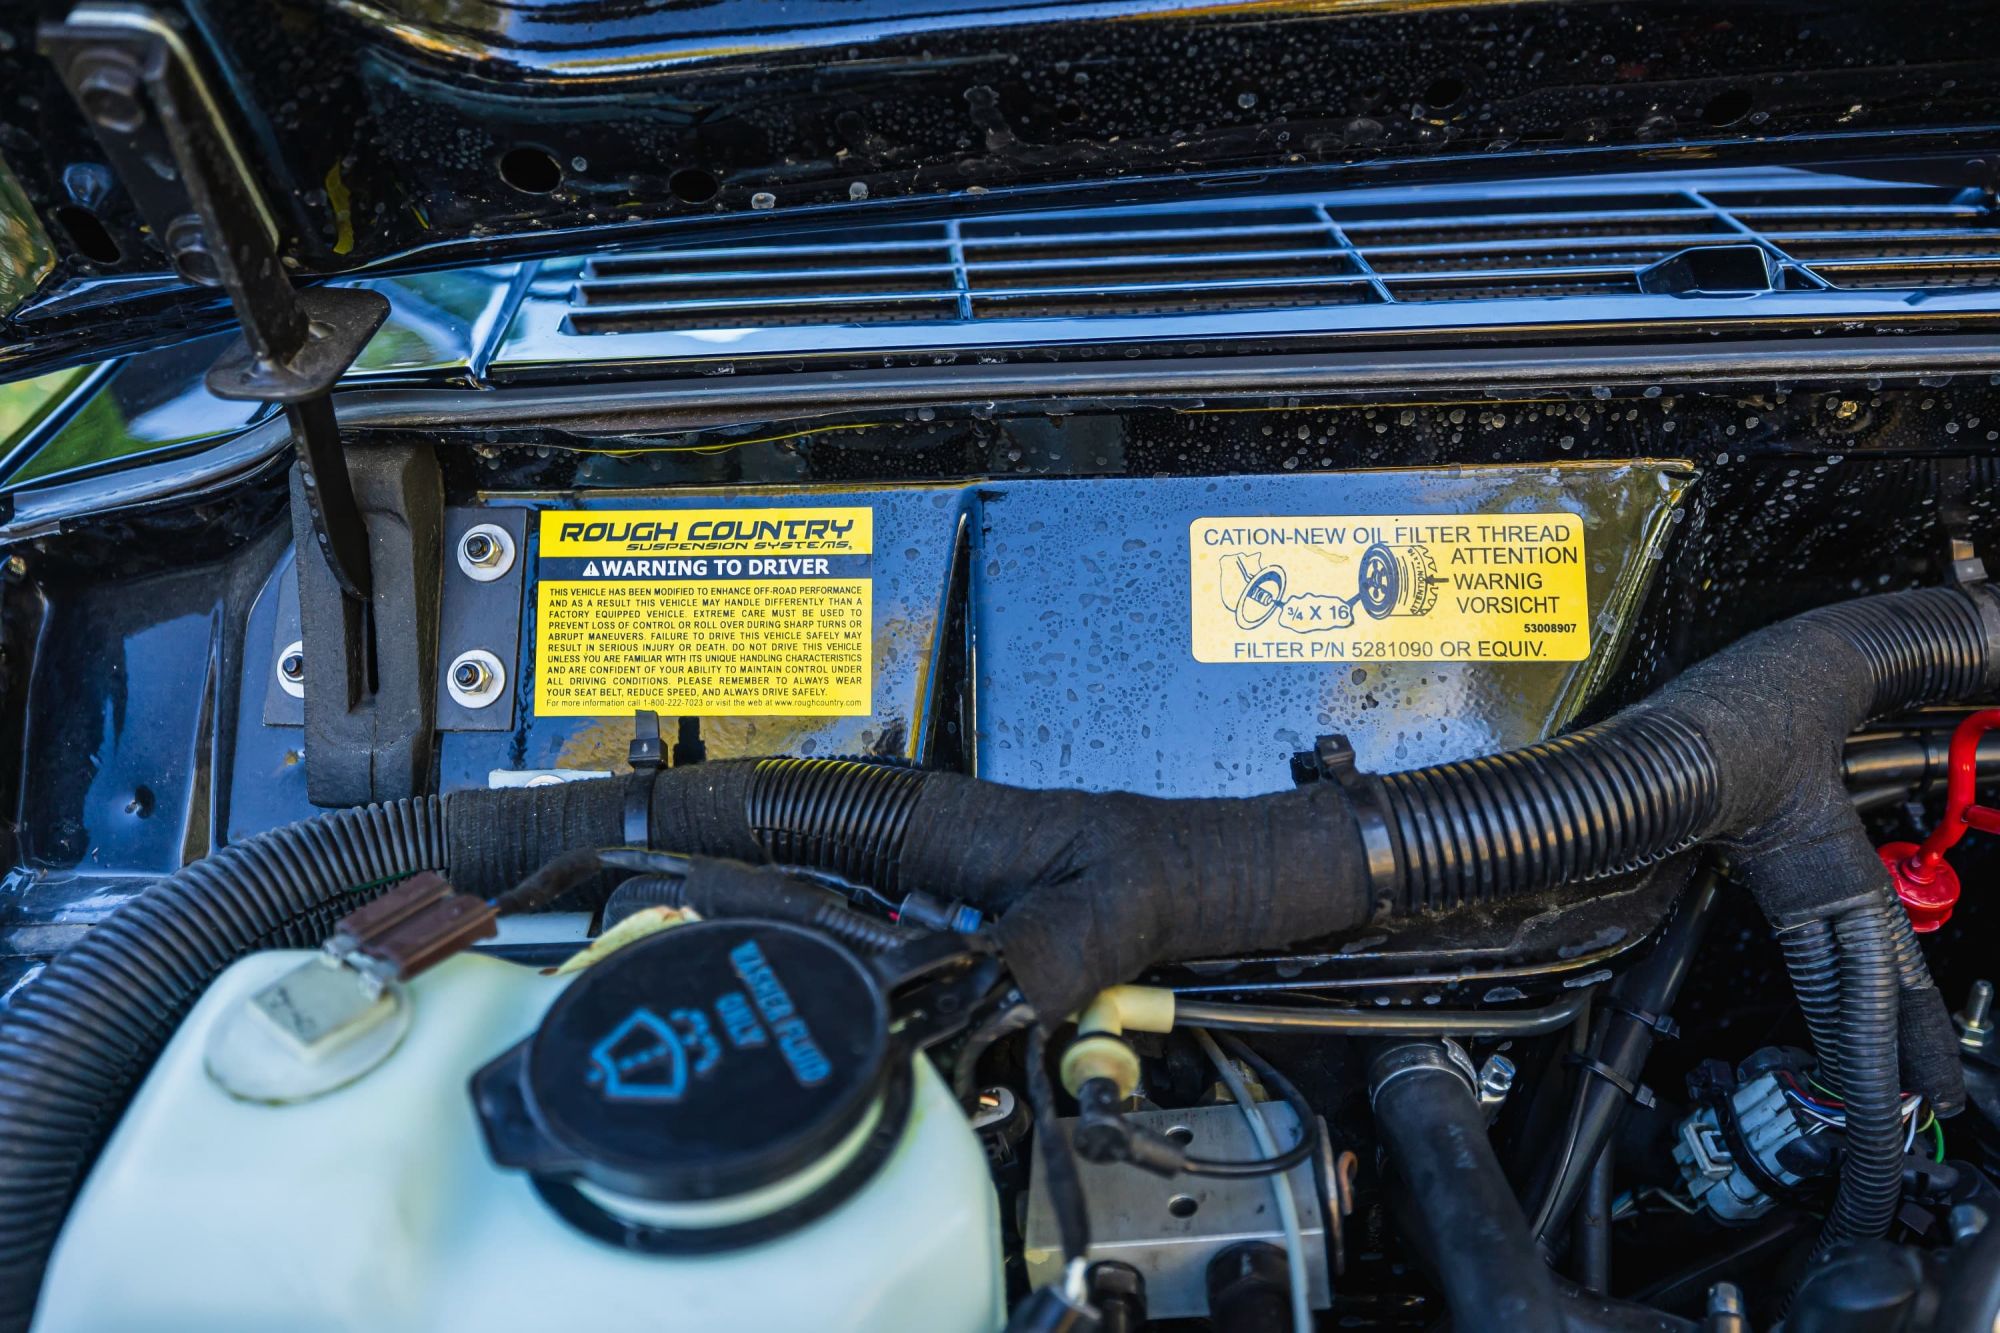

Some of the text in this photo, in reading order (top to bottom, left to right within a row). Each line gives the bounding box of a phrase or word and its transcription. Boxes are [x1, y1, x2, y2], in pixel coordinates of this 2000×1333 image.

[560, 520, 854, 542] ROUGH COUNTRY
[1204, 525, 1570, 545] CATION-NEW OIL FILTER THREAD
[626, 542, 748, 550] SUSPENSION
[1450, 546, 1578, 564] ATTENTION
[601, 558, 830, 576] WARNING TO DRIVER
[1453, 573, 1543, 590] WARNIG
[550, 588, 568, 596] THIS
[608, 588, 626, 596] HAS
[628, 588, 652, 596] BEEN
[654, 587, 695, 595] MODIFIED
[697, 587, 709, 595] TO
[710, 587, 751, 595] ENHANCE
[753, 587, 797, 595] OFF-ROAD
[799, 586, 862, 595] PERFORMANCE
[1410, 570, 1425, 615] ATTENTION
[1456, 596, 1560, 614] VORSICHT
[548, 610, 590, 618] FACTORY
[595, 610, 641, 618] EQUIPPED
[693, 610, 736, 618] EXTREME
[741, 609, 766, 618] CARE
[771, 609, 797, 617] MUST
[802, 609, 814, 617] BE
[820, 609, 845, 617] USED
[850, 609, 863, 617] TO
[1309, 605, 1322, 620] X
[1329, 605, 1349, 620] 16
[548, 620, 862, 629] PREVENT LOSS OF CONTROL OR ROLL OVER DURING SHARP TURNS OR
[1524, 623, 1577, 633] 53008907
[642, 643, 675, 651] INJURY
[1234, 640, 1547, 658] FILTER P/N 5281090 OR EQUIV.
[547, 654, 862, 662] UNLESS YOU ARE FAMILIAR WITH ITS UNIQUE HANDLING CHARACTERISTICS
[568, 666, 586, 674] ARE
[644, 666, 656, 674] OF
[687, 666, 722, 674] ABILITY
[725, 666, 737, 674] TO
[740, 665, 782, 673] MAINTAIN
[785, 665, 828, 673] CONTROL
[831, 665, 862, 673] UNDER
[546, 688, 827, 698] YOUR SEAT BELT, REDUCE SPEED, AND ALWAYS DRIVE SAFELY.
[774, 699, 862, 708] www.roughcountry.com
